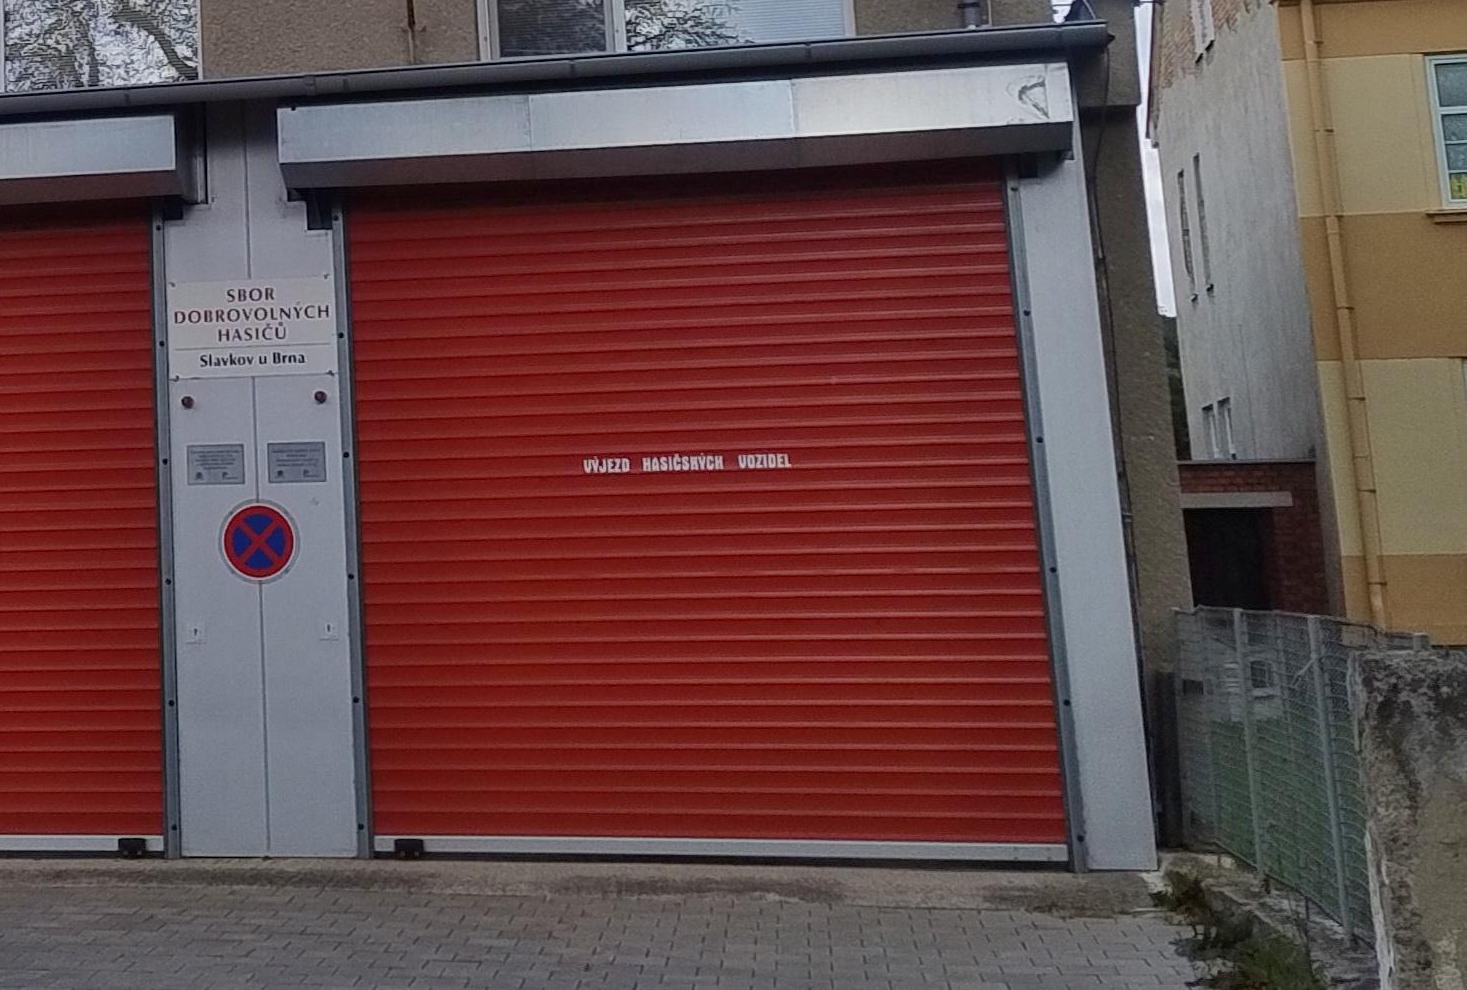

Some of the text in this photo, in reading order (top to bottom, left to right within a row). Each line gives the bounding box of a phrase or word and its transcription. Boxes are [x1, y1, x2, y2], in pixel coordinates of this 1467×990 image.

[225, 287, 276, 303] SBOR
[173, 301, 330, 325] DOBROVOLNÝCH
[217, 322, 288, 343] HASIČŮ
[199, 352, 306, 368] Slavkov u Brna
[583, 453, 792, 474] VÝJEZD HASIČSKÝCH VOZIDEL
